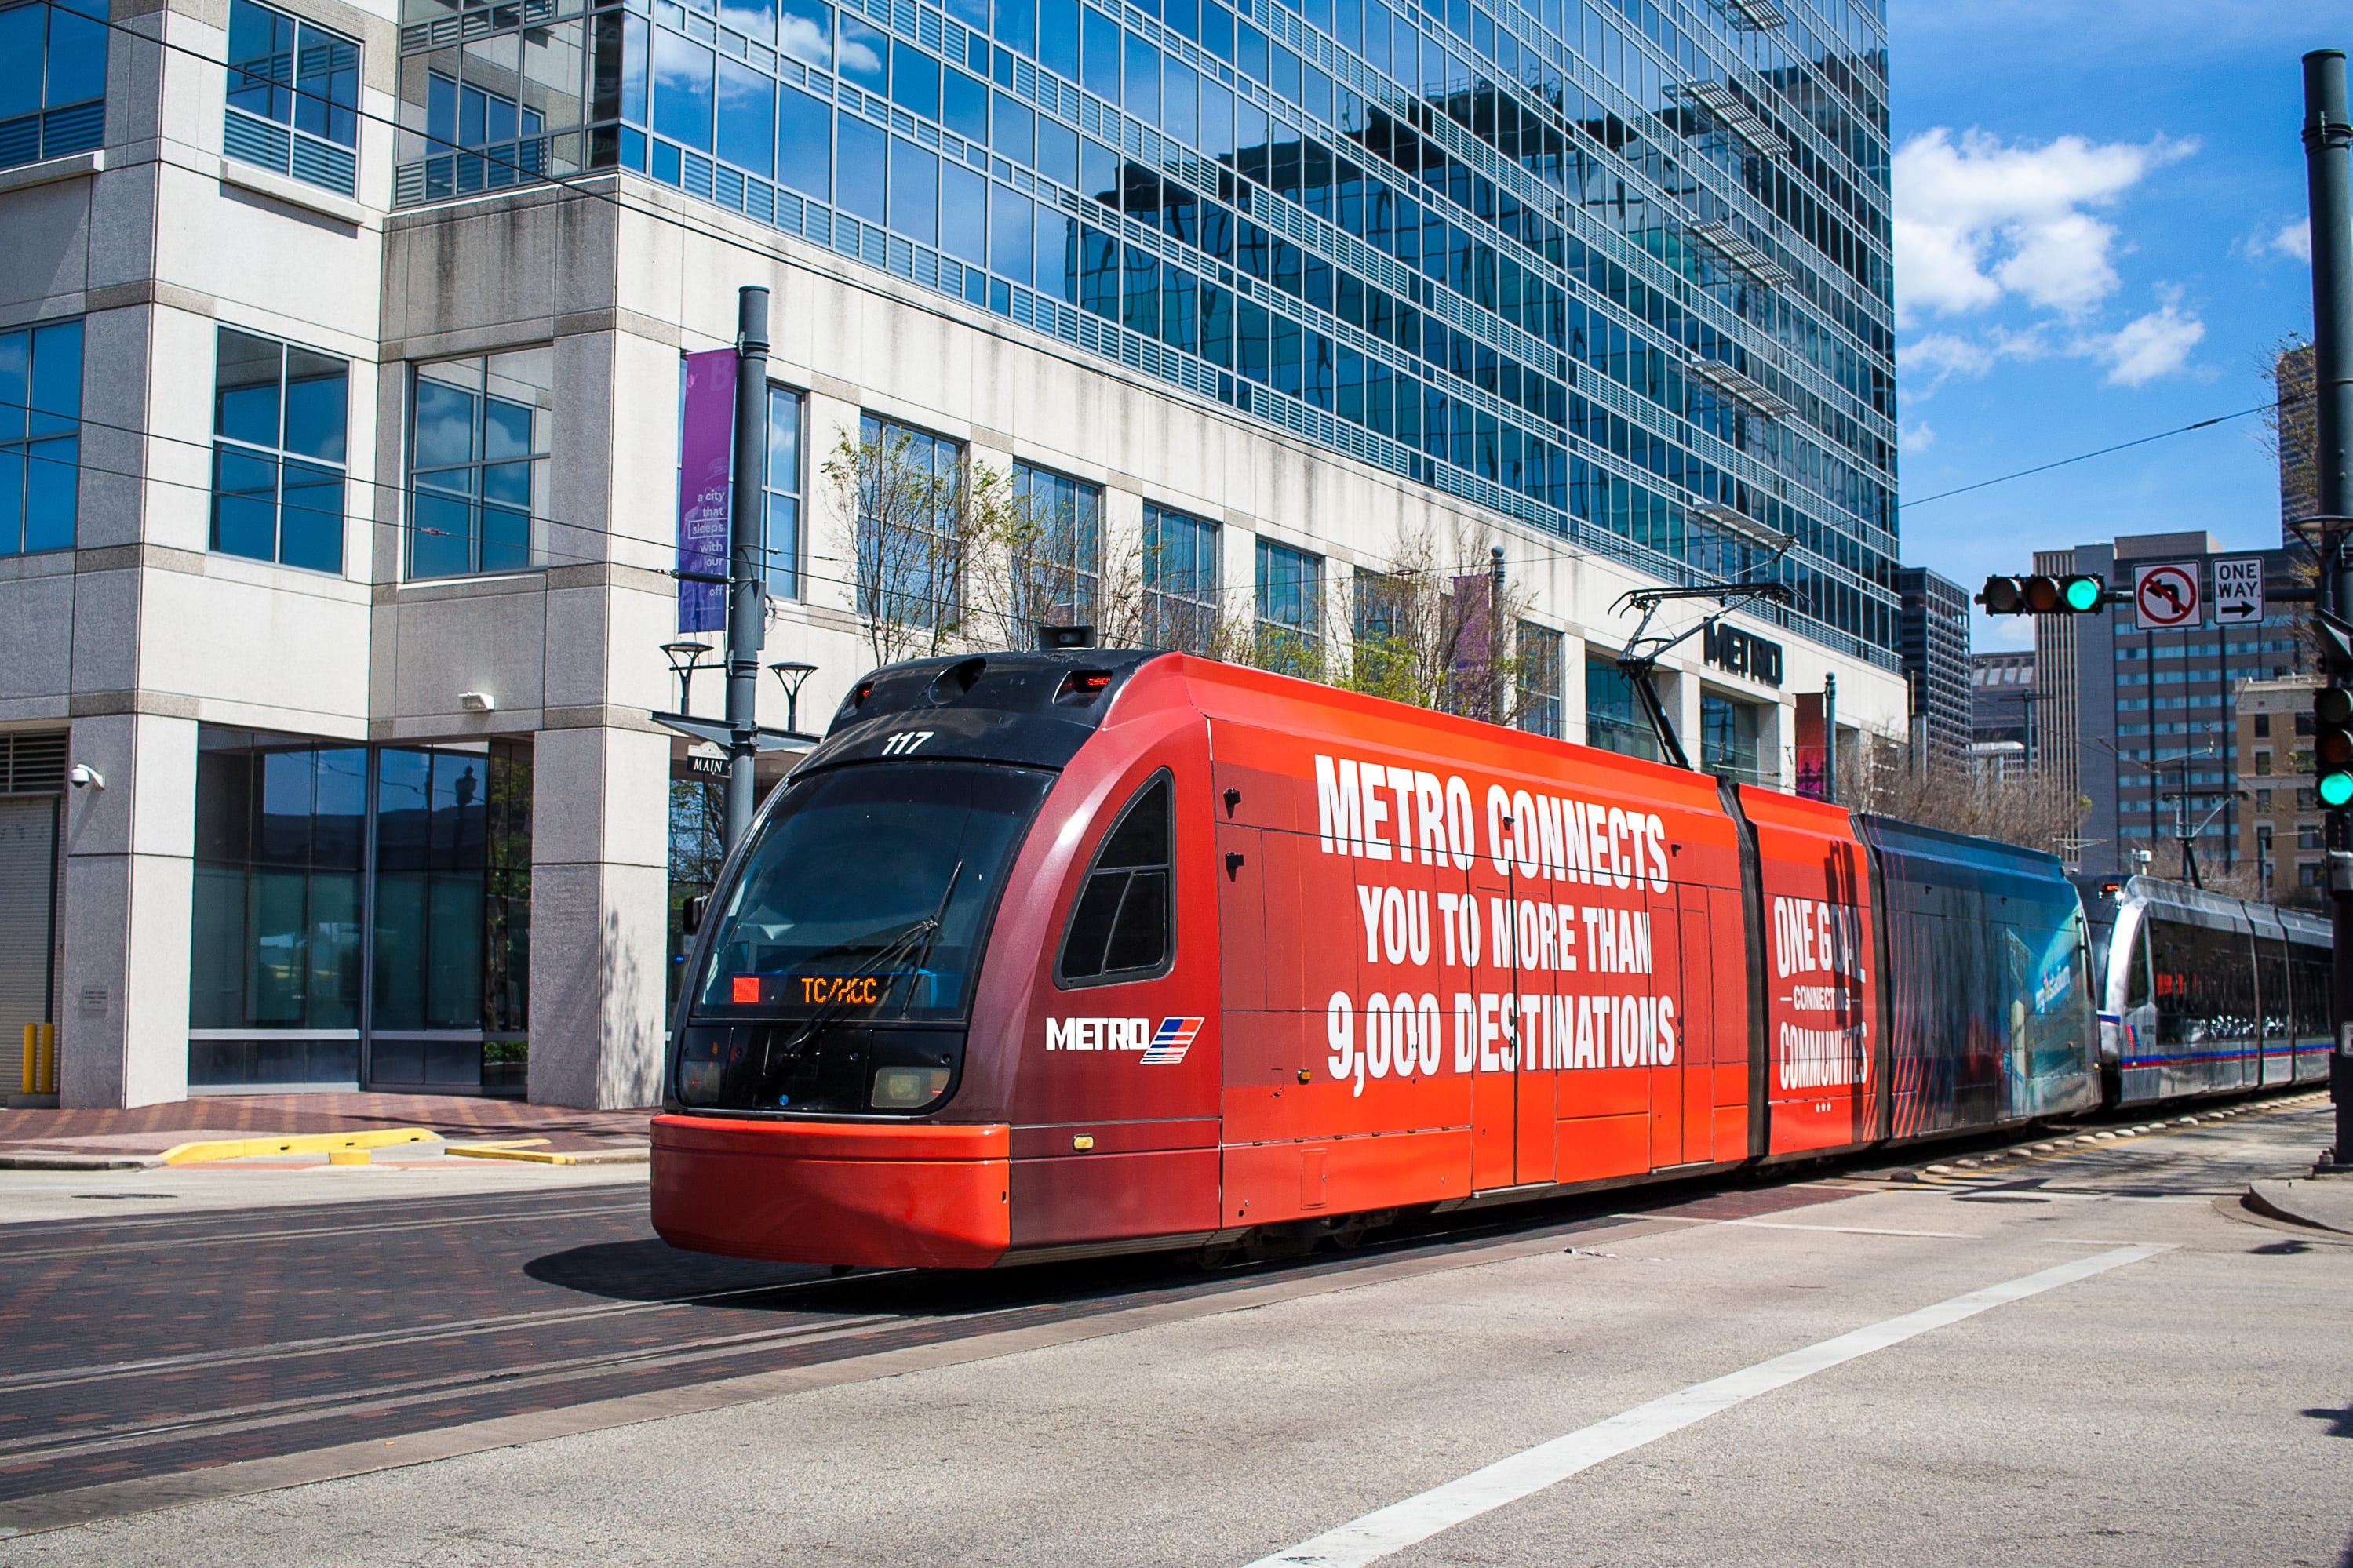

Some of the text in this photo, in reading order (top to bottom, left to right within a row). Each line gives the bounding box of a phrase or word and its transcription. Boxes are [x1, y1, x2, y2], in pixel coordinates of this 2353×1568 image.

[697, 489, 725, 503] a city
[702, 507, 724, 518] that
[692, 522, 723, 535] sleeps
[700, 540, 723, 553] with
[706, 558, 723, 567] our
[2219, 563, 2257, 580] ONE
[709, 584, 723, 597] off
[2218, 581, 2258, 598] WAY
[1703, 617, 1783, 686] METRO
[881, 731, 934, 755] 117
[693, 758, 723, 773] MAIN
[1315, 755, 1669, 893] METRO CONNECTS
[1357, 885, 1652, 974] YOU TO MORE THAN
[1774, 897, 1866, 984] ONE GOAL
[1794, 985, 1851, 1011] CONNECTING
[1046, 1017, 1149, 1050] METRO
[1327, 991, 1675, 1097] 9,000 DESTINATIONS
[1779, 1021, 1868, 1090] COMMUNITIES
